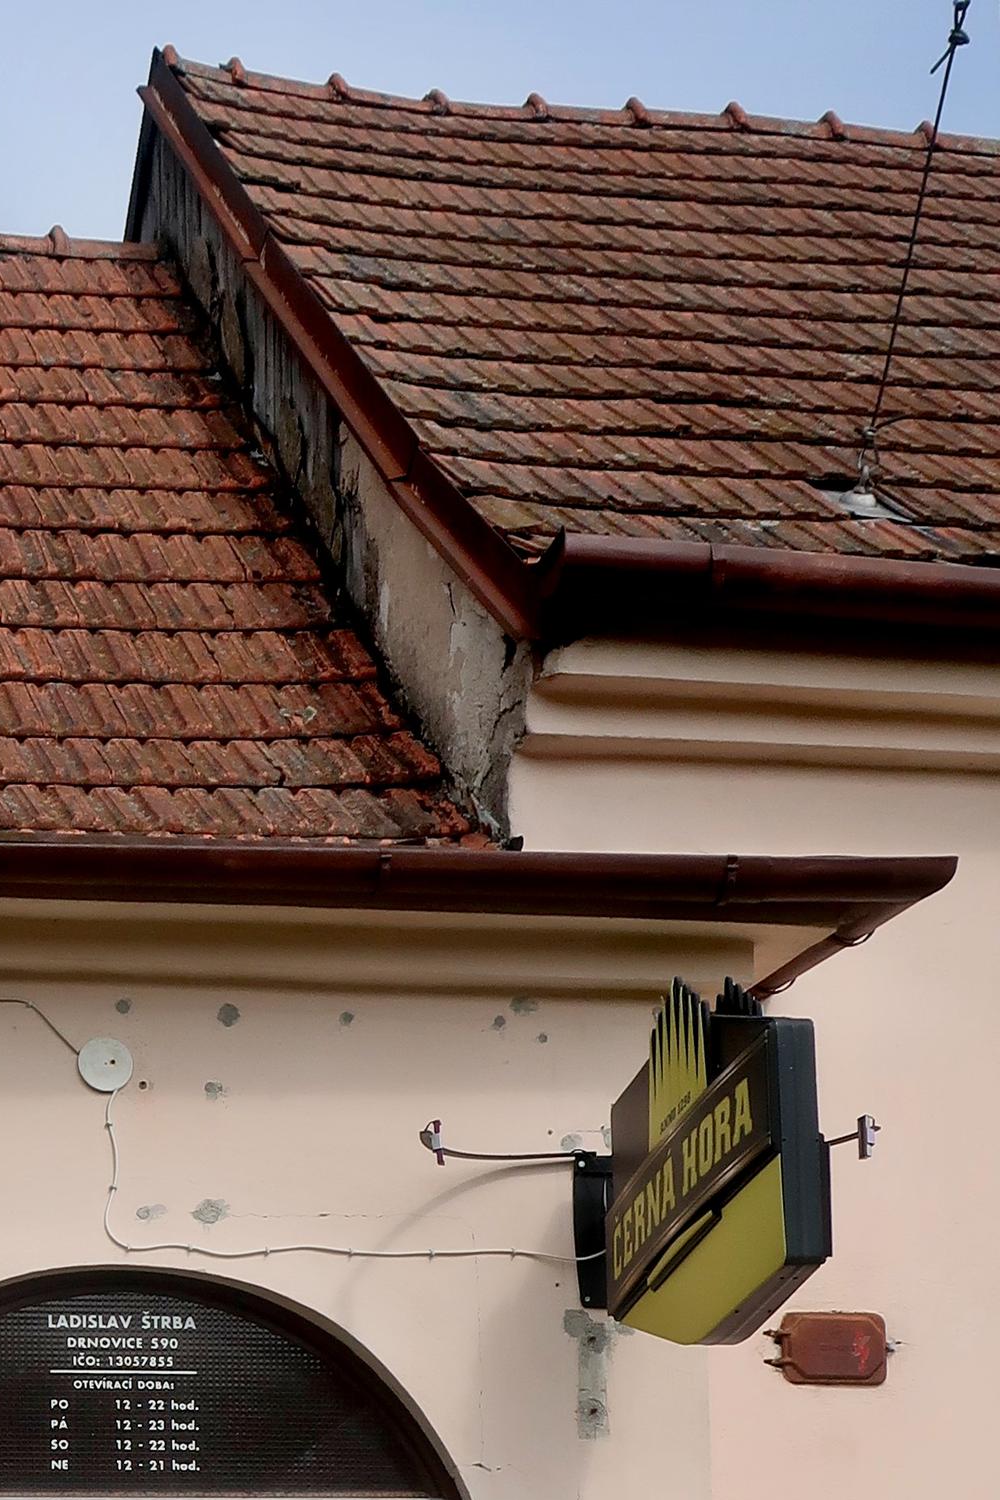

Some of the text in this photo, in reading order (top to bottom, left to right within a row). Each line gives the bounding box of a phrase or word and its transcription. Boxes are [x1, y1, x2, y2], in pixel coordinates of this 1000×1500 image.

[613, 1077, 752, 1281] ČERNÁ HORA
[48, 1311, 197, 1330] LADISLAV ŠTRBA
[67, 1337, 178, 1349] DRNOVICE 590
[73, 1352, 174, 1367] IČO: 13057855
[73, 1377, 174, 1390] OTEVÍRACÍ DOBA:
[50, 1399, 69, 1409] PO
[115, 1400, 131, 1410] 12
[149, 1400, 165, 1410] 22
[171, 1399, 200, 1411] hod.
[50, 1416, 68, 1429] PÁ
[116, 1420, 131, 1430] 12
[149, 1420, 165, 1430] 23
[171, 1419, 200, 1431] hod.
[50, 1439, 69, 1450] SO
[116, 1440, 132, 1450] 12
[149, 1440, 165, 1450] 22
[171, 1439, 200, 1451] hod.
[51, 1460, 69, 1470] NE
[116, 1460, 132, 1471] 12
[150, 1460, 165, 1471] 21
[172, 1459, 200, 1471] hod.
